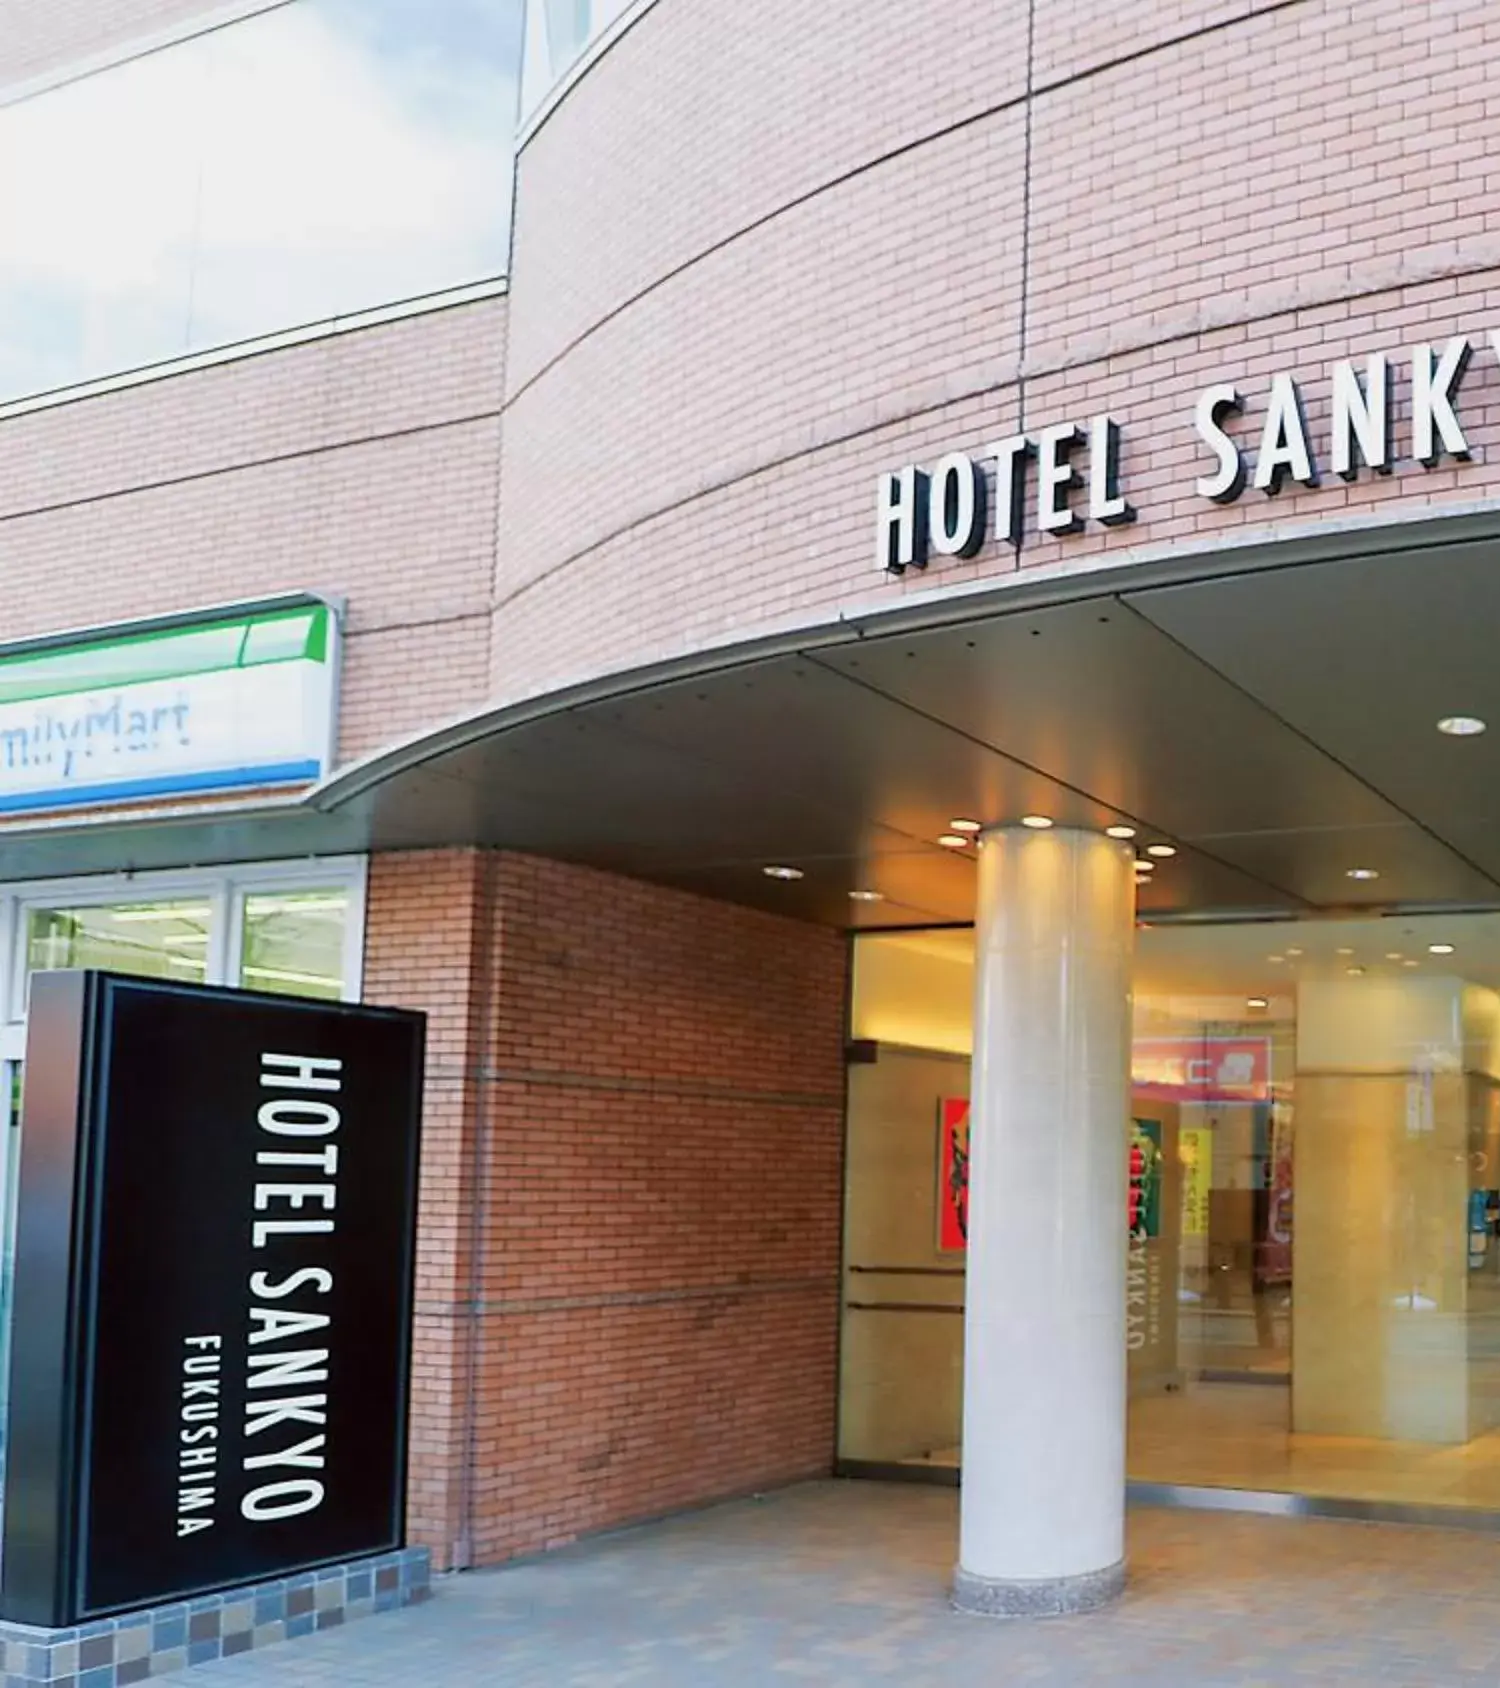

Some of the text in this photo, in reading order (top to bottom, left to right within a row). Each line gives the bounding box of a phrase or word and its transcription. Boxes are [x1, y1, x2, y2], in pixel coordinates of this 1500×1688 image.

[875, 415, 1132, 572] HOTEL
[239, 1052, 343, 1522] HOTEL SANKYO
[176, 1334, 222, 1538] FUKUSHIMA
